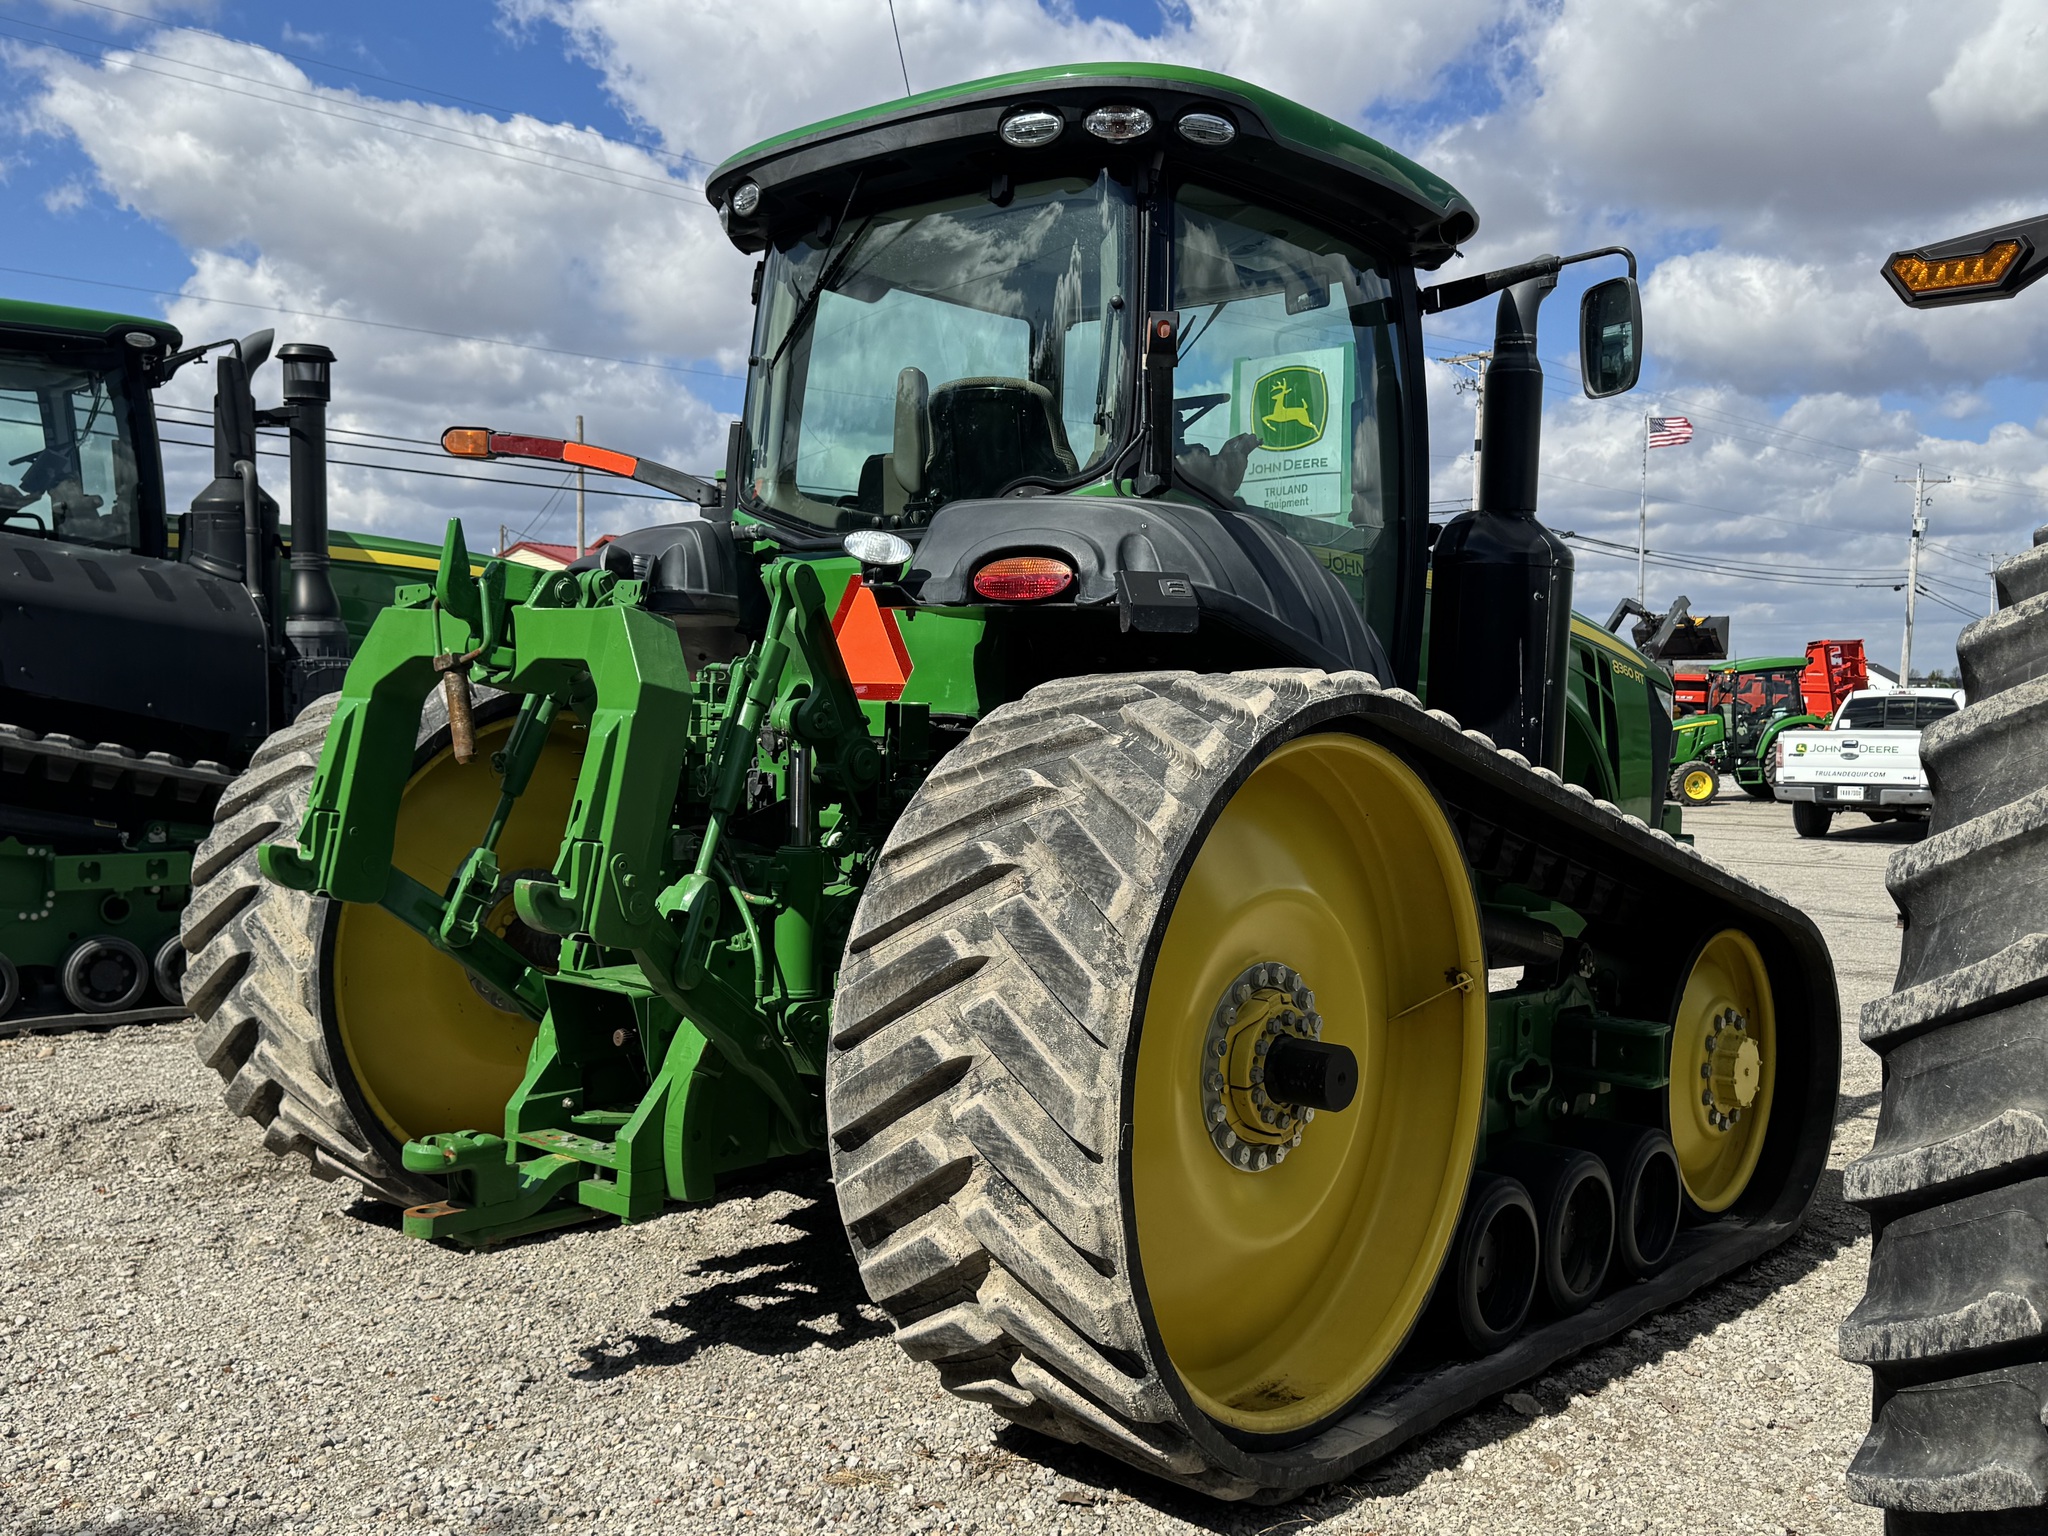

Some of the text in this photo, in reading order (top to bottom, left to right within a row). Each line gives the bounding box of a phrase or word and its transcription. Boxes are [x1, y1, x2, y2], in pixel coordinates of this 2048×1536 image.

[1248, 458, 1328, 476] JOHN DEERE
[1265, 484, 1308, 498] TRULAND
[1264, 497, 1309, 510] Equipment
[1612, 659, 1634, 679] 8360
[1810, 743, 1899, 754] JOHN DEERE
[1815, 770, 1886, 778] TRULANDEQUIP.COM
